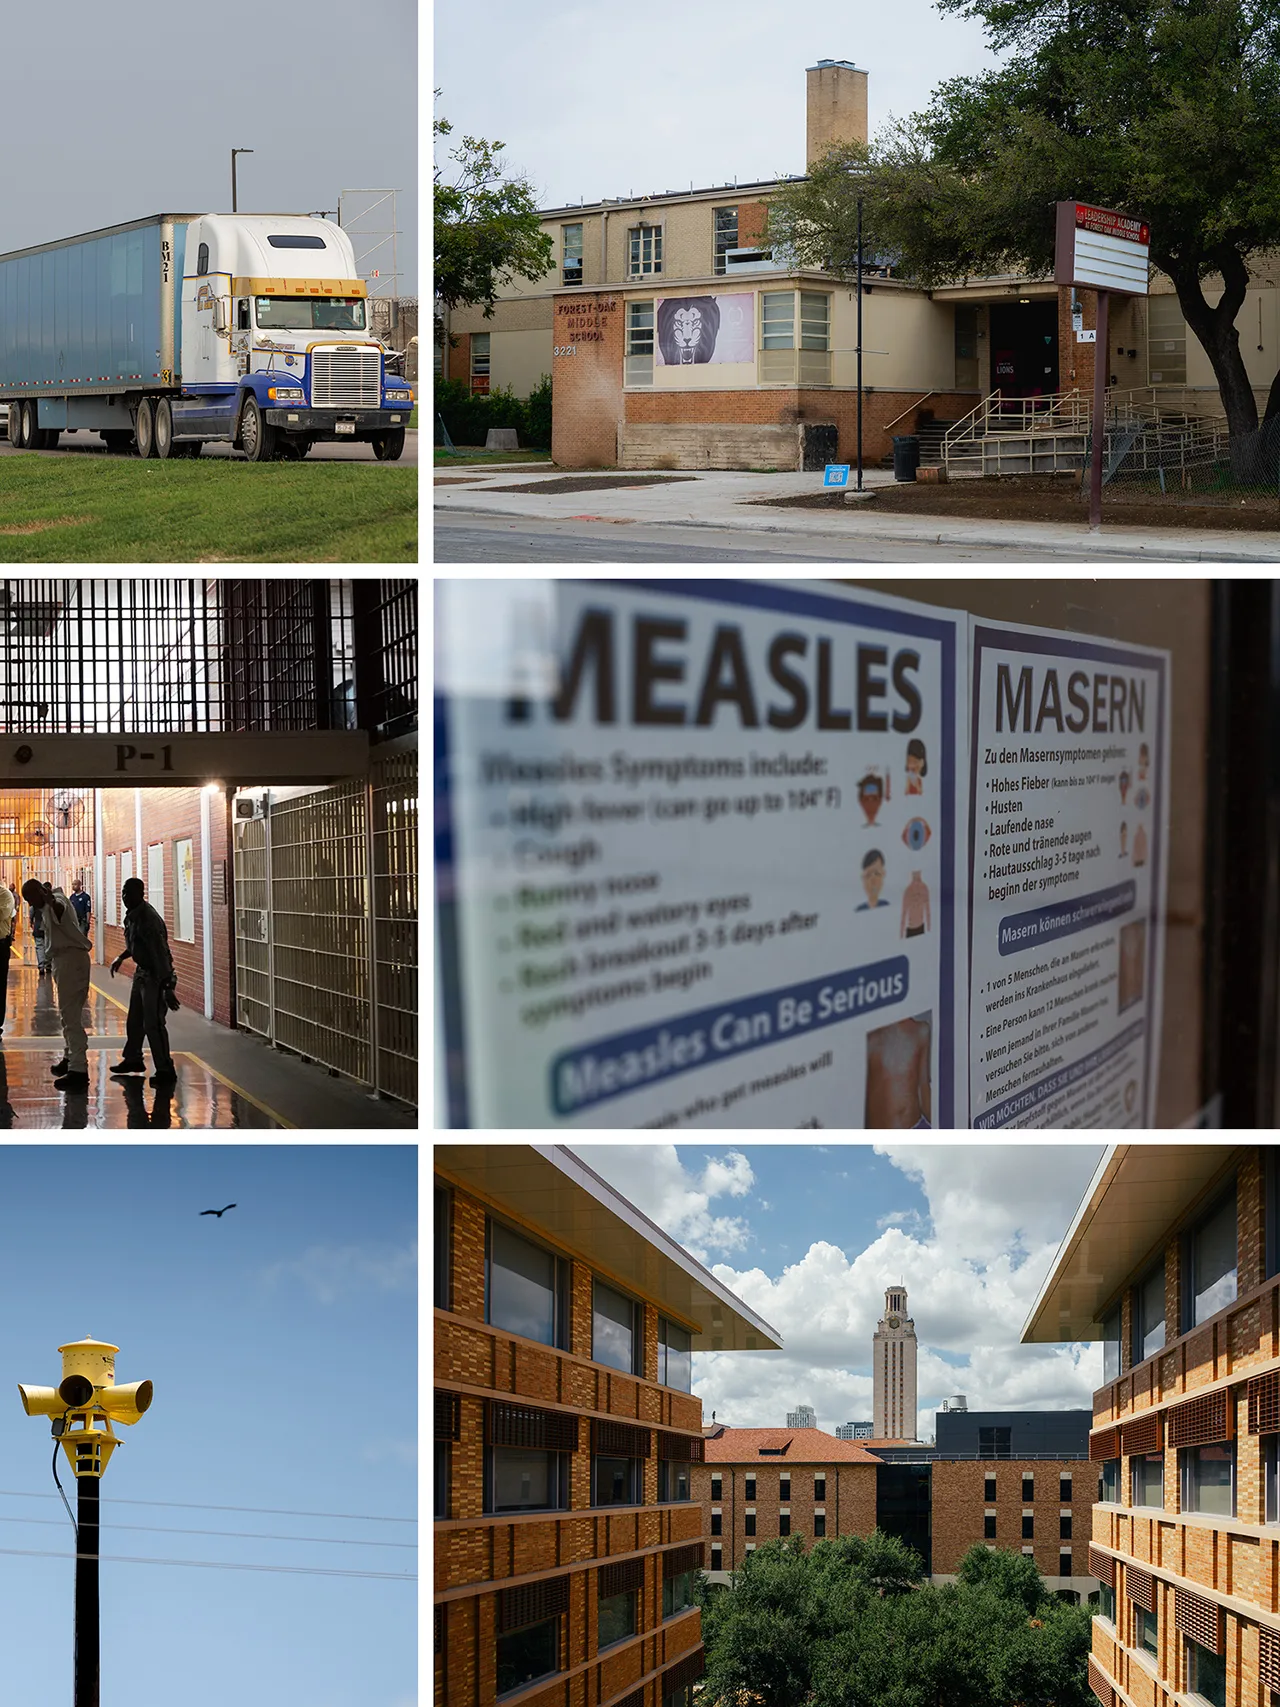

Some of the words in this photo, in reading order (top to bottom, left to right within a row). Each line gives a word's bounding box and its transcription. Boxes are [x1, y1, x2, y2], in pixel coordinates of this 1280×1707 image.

[1084, 209, 1116, 226] LEADERSHIP
[1117, 217, 1142, 233] ACADEMY
[1126, 231, 1140, 241] SCHOOL
[567, 316, 607, 329] MIDDLE
[570, 331, 605, 342] SCHOOL
[554, 346, 577, 356] 3221
[996, 365, 1014, 374] LIONS
[505, 606, 923, 734] MEASLES
[995, 662, 1146, 734] MASERN
[115, 744, 174, 772] P-1
[984, 748, 997, 764] Zu
[999, 748, 1018, 763] den
[1019, 747, 1100, 765] Masernsymptomen
[611, 751, 745, 790] Symptoms
[748, 751, 829, 778] include:
[991, 778, 1020, 793] Hohes
[1021, 776, 1050, 790] Fieber
[1052, 777, 1069, 789] (kann
[1069, 776, 1078, 786] bis
[990, 800, 1023, 814] Husten
[990, 817, 1033, 836] Laufende
[1034, 816, 1054, 830] nase
[989, 843, 1011, 858] Rote
[1012, 838, 1031, 854] und
[1032, 832, 1069, 850] tränende
[1070, 830, 1092, 845] augen
[989, 855, 1054, 880] Hautausschlag
[1055, 852, 1068, 866] 3-5
[1069, 850, 1085, 865] tage
[988, 882, 1020, 901] beginn
[1022, 878, 1037, 893] der
[1039, 870, 1080, 889] symptome
[704, 893, 752, 919] eyes
[730, 920, 776, 946] days
[779, 910, 820, 936] after
[1001, 922, 1038, 944] Masern
[1039, 916, 1072, 934] können
[650, 960, 713, 993] begin
[992, 978, 1006, 991] von
[1007, 973, 1013, 985] 5
[1050, 957, 1060, 969] die
[1061, 954, 1070, 965] an
[985, 993, 1014, 1013] werden
[1014, 989, 1025, 1001] ins
[1025, 973, 1068, 997] Krankenhaus
[985, 1024, 1002, 1038] Eine
[1002, 1012, 1028, 1030] Person
[1028, 1005, 1045, 1020] kann
[1046, 999, 1054, 1011] 12
[560, 1028, 706, 1102] Measles
[710, 1011, 772, 1052] Can
[777, 997, 813, 1033] Be
[818, 972, 904, 1019] Serious
[985, 1044, 1007, 1060] Wenn
[1007, 1030, 1034, 1055] jemand
[1034, 1028, 1042, 1040] in
[985, 1057, 1023, 1082] versuchen
[1023, 1051, 1033, 1064] Sie
[1051, 1036, 1064, 1050] sich
[979, 1112, 995, 1129] WIR
[1037, 1077, 1057, 1099] DASS
[985, 1076, 1021, 1103] Menschen
